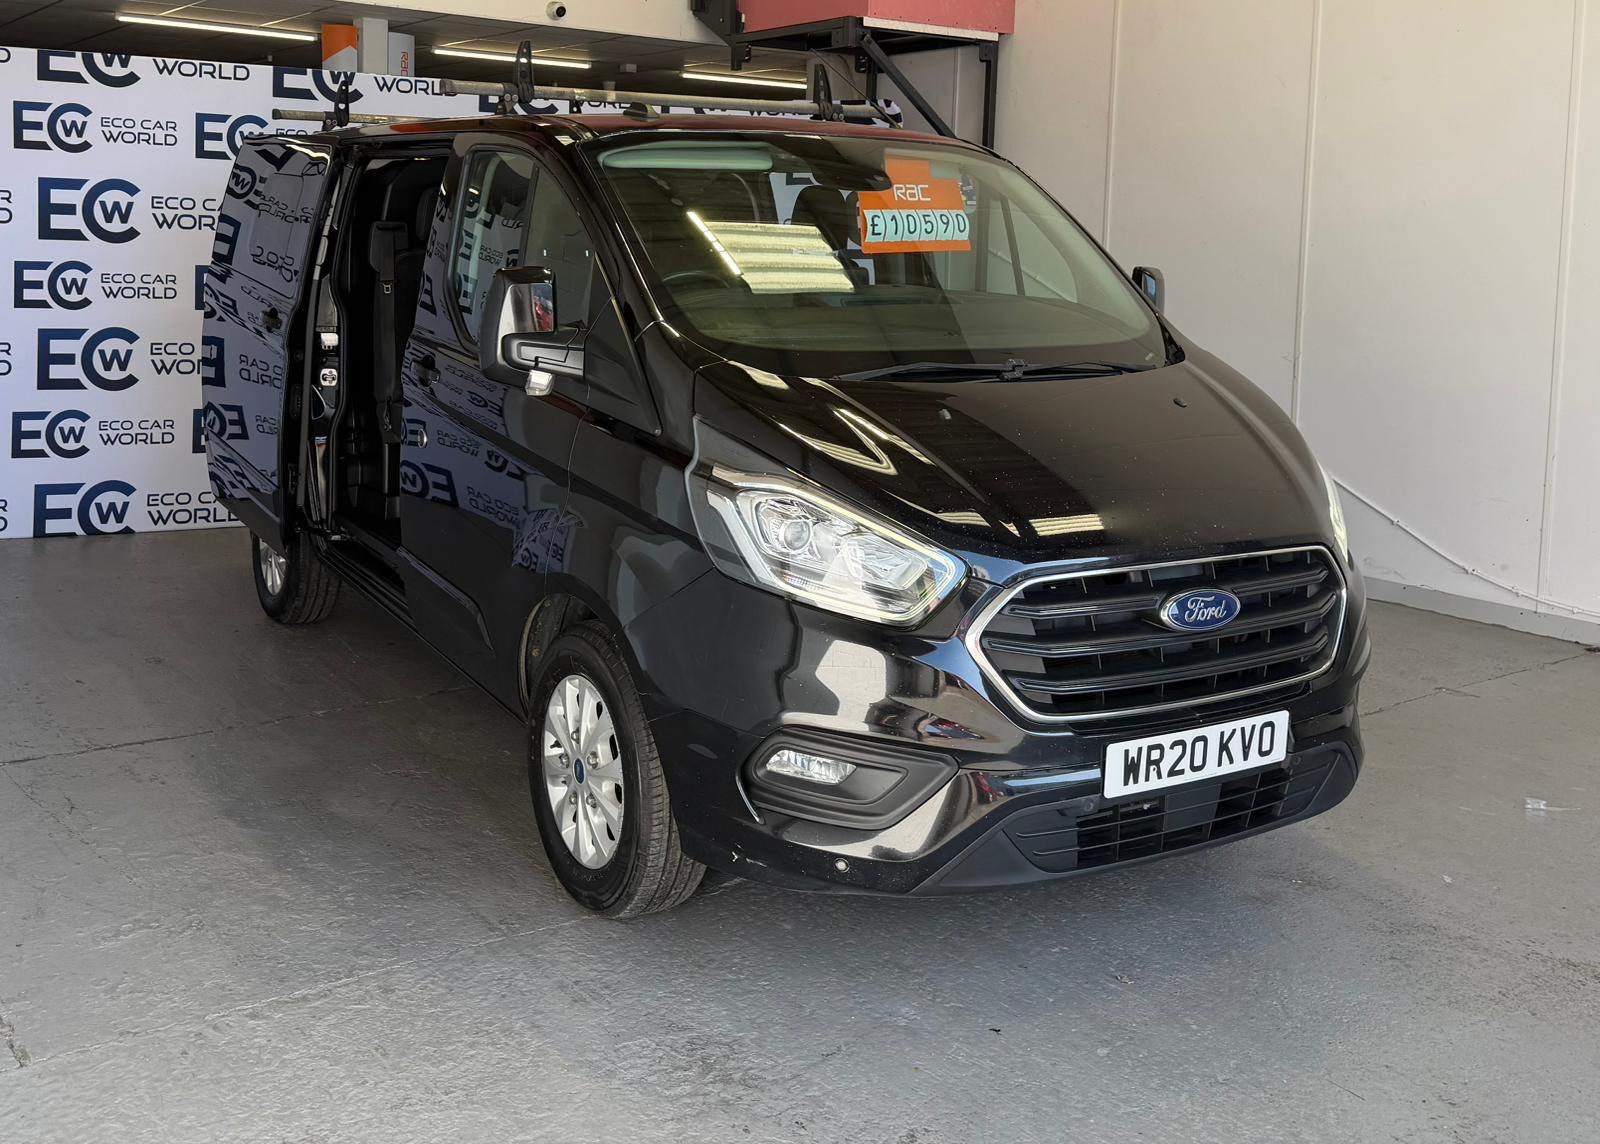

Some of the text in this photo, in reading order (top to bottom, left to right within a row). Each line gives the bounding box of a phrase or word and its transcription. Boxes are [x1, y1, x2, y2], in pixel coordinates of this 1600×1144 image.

[152, 58, 250, 81] WORLD
[373, 75, 458, 97] WORL
[100, 116, 177, 132] ECO CAR
[101, 130, 178, 147] WORLD
[195, 112, 269, 160] EC
[150, 195, 196, 211] ECO
[152, 212, 216, 231] WOR
[870, 213, 967, 236] £10590
[100, 272, 177, 285] ECO CAR
[101, 286, 177, 299] WORLD
[150, 342, 195, 355] ECO
[98, 419, 175, 431] ECO CAR
[99, 432, 175, 446] WORLD
[146, 492, 191, 506] ECO
[1184, 596, 1227, 623] Ford
[1123, 720, 1276, 786] WR20 KVO
